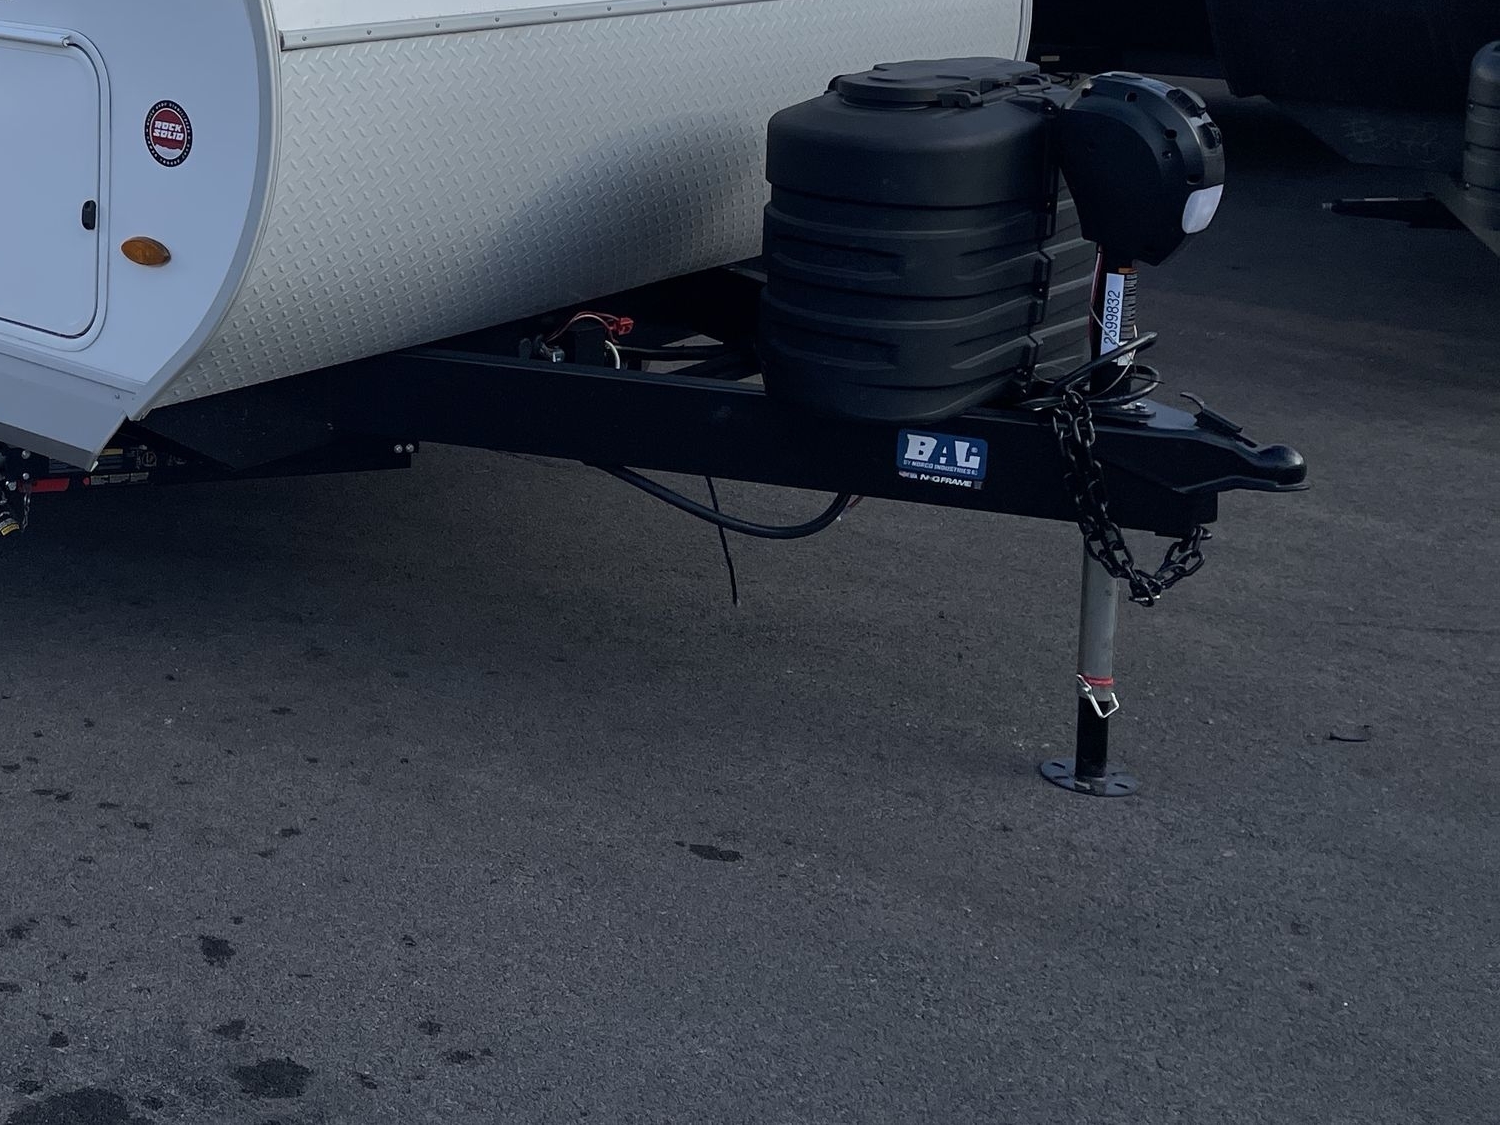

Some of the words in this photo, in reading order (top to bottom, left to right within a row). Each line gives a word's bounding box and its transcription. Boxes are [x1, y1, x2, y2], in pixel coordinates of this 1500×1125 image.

[154, 120, 183, 132] ROCK
[153, 129, 184, 141] SOLID
[904, 433, 980, 469] BAL
